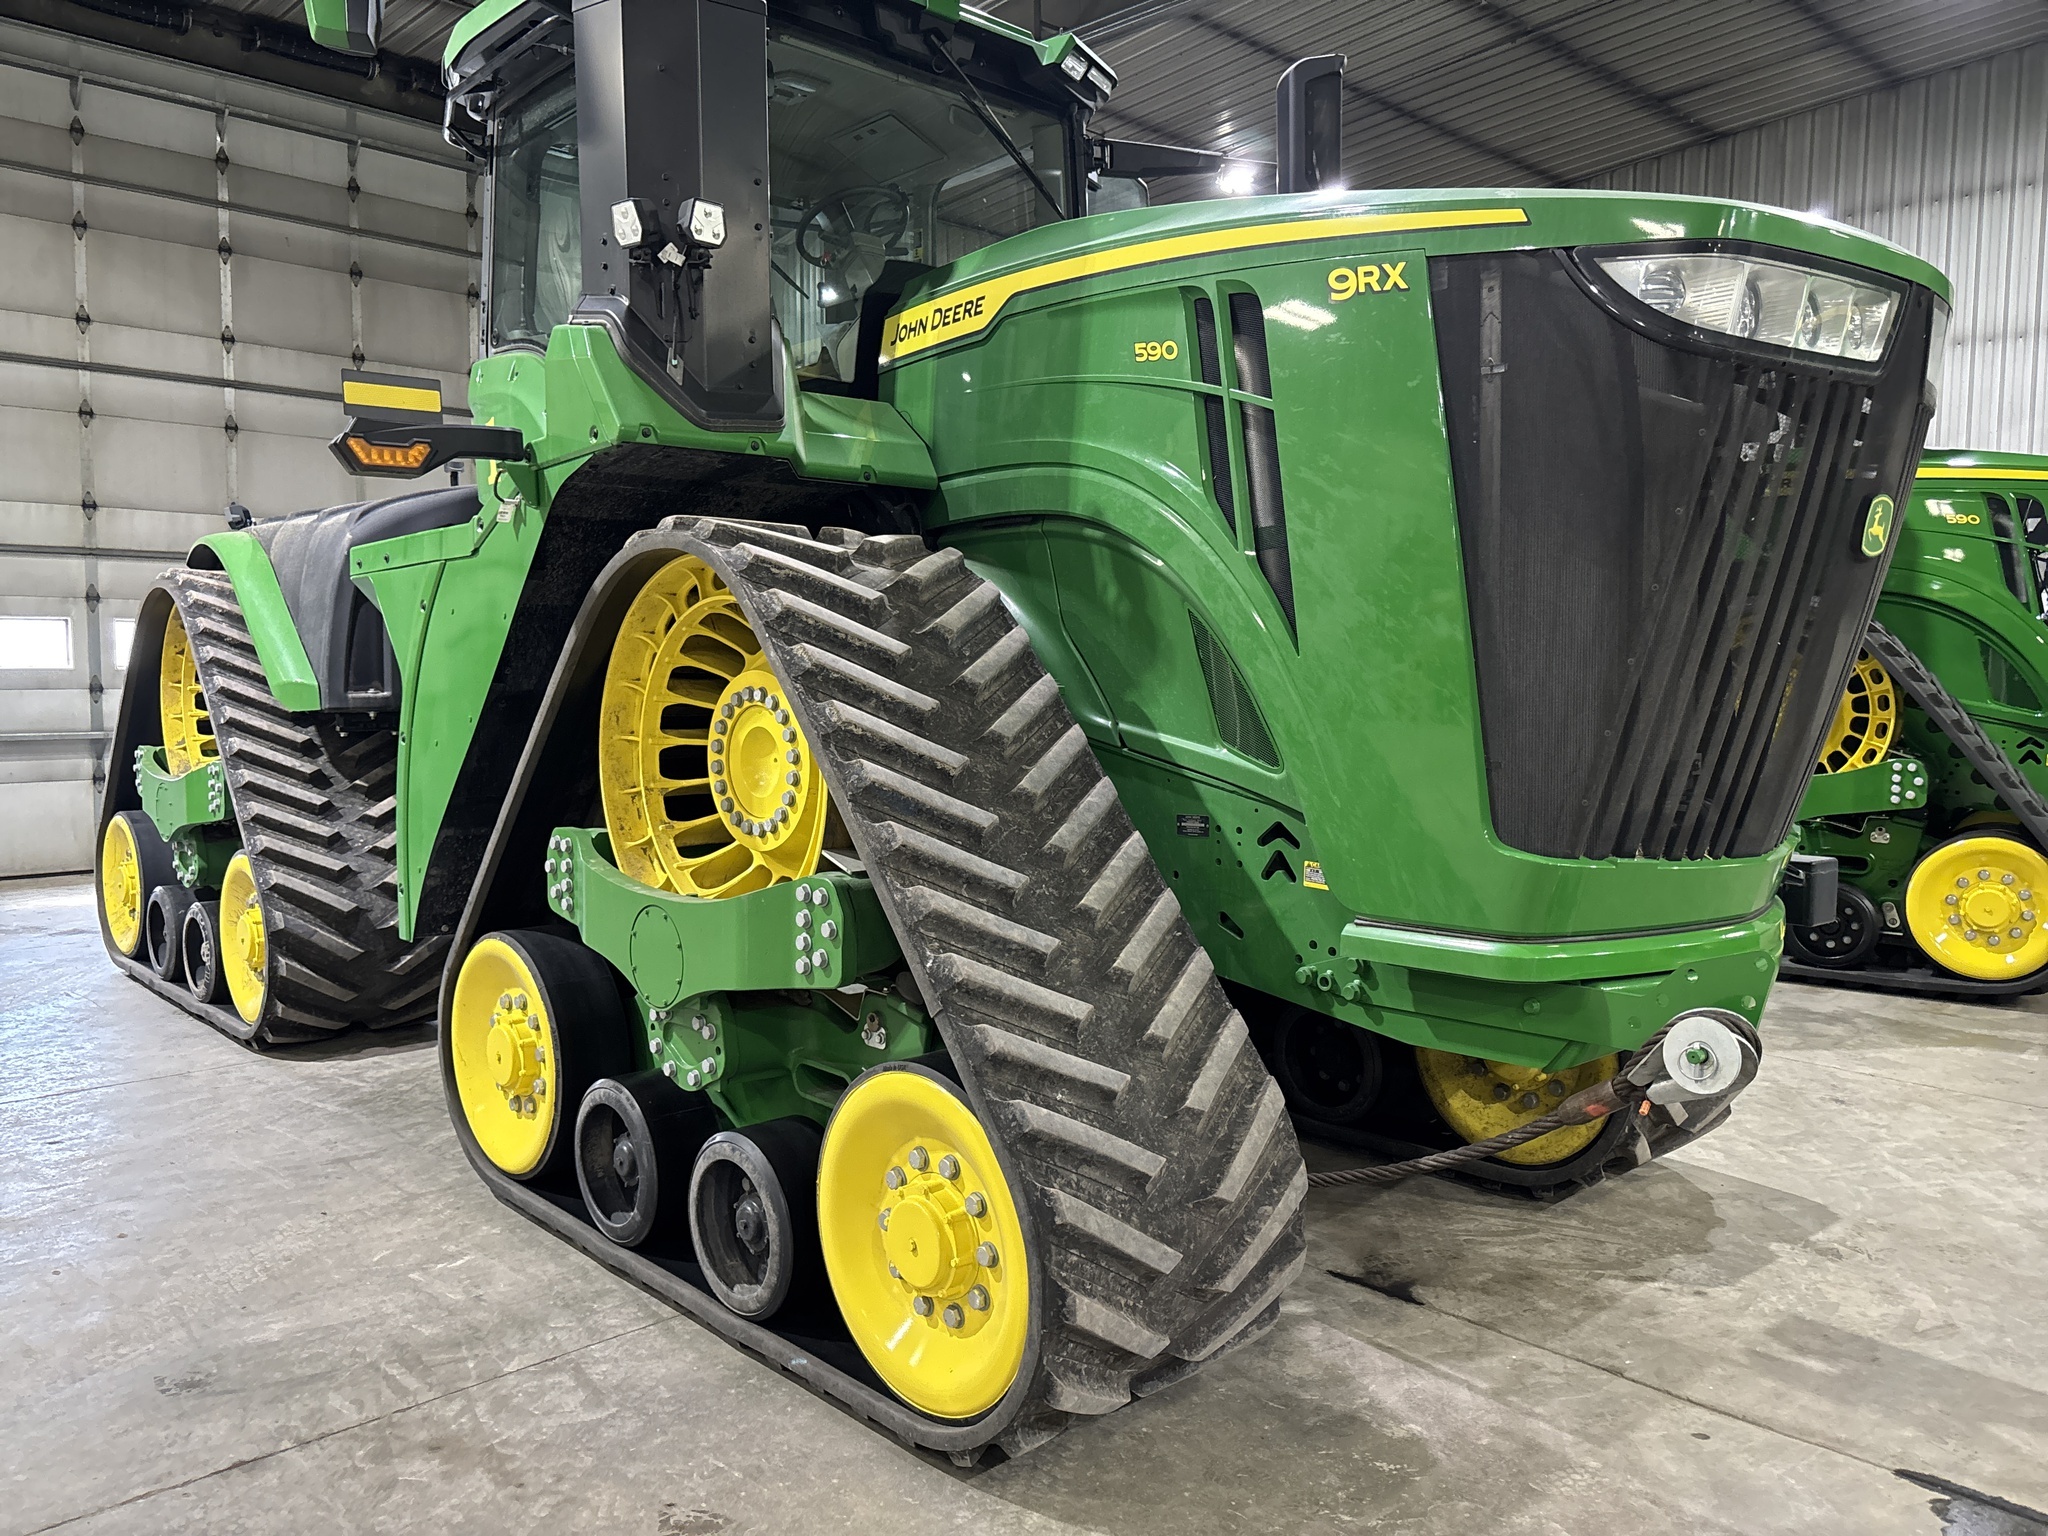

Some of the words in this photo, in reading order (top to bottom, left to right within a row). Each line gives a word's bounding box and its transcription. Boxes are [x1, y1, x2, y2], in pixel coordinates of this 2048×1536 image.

[1327, 261, 1409, 302] 9RX
[890, 315, 929, 346] JOHN
[930, 295, 986, 332] DEERE
[1134, 339, 1179, 363] 590
[1945, 513, 1981, 525] 590
